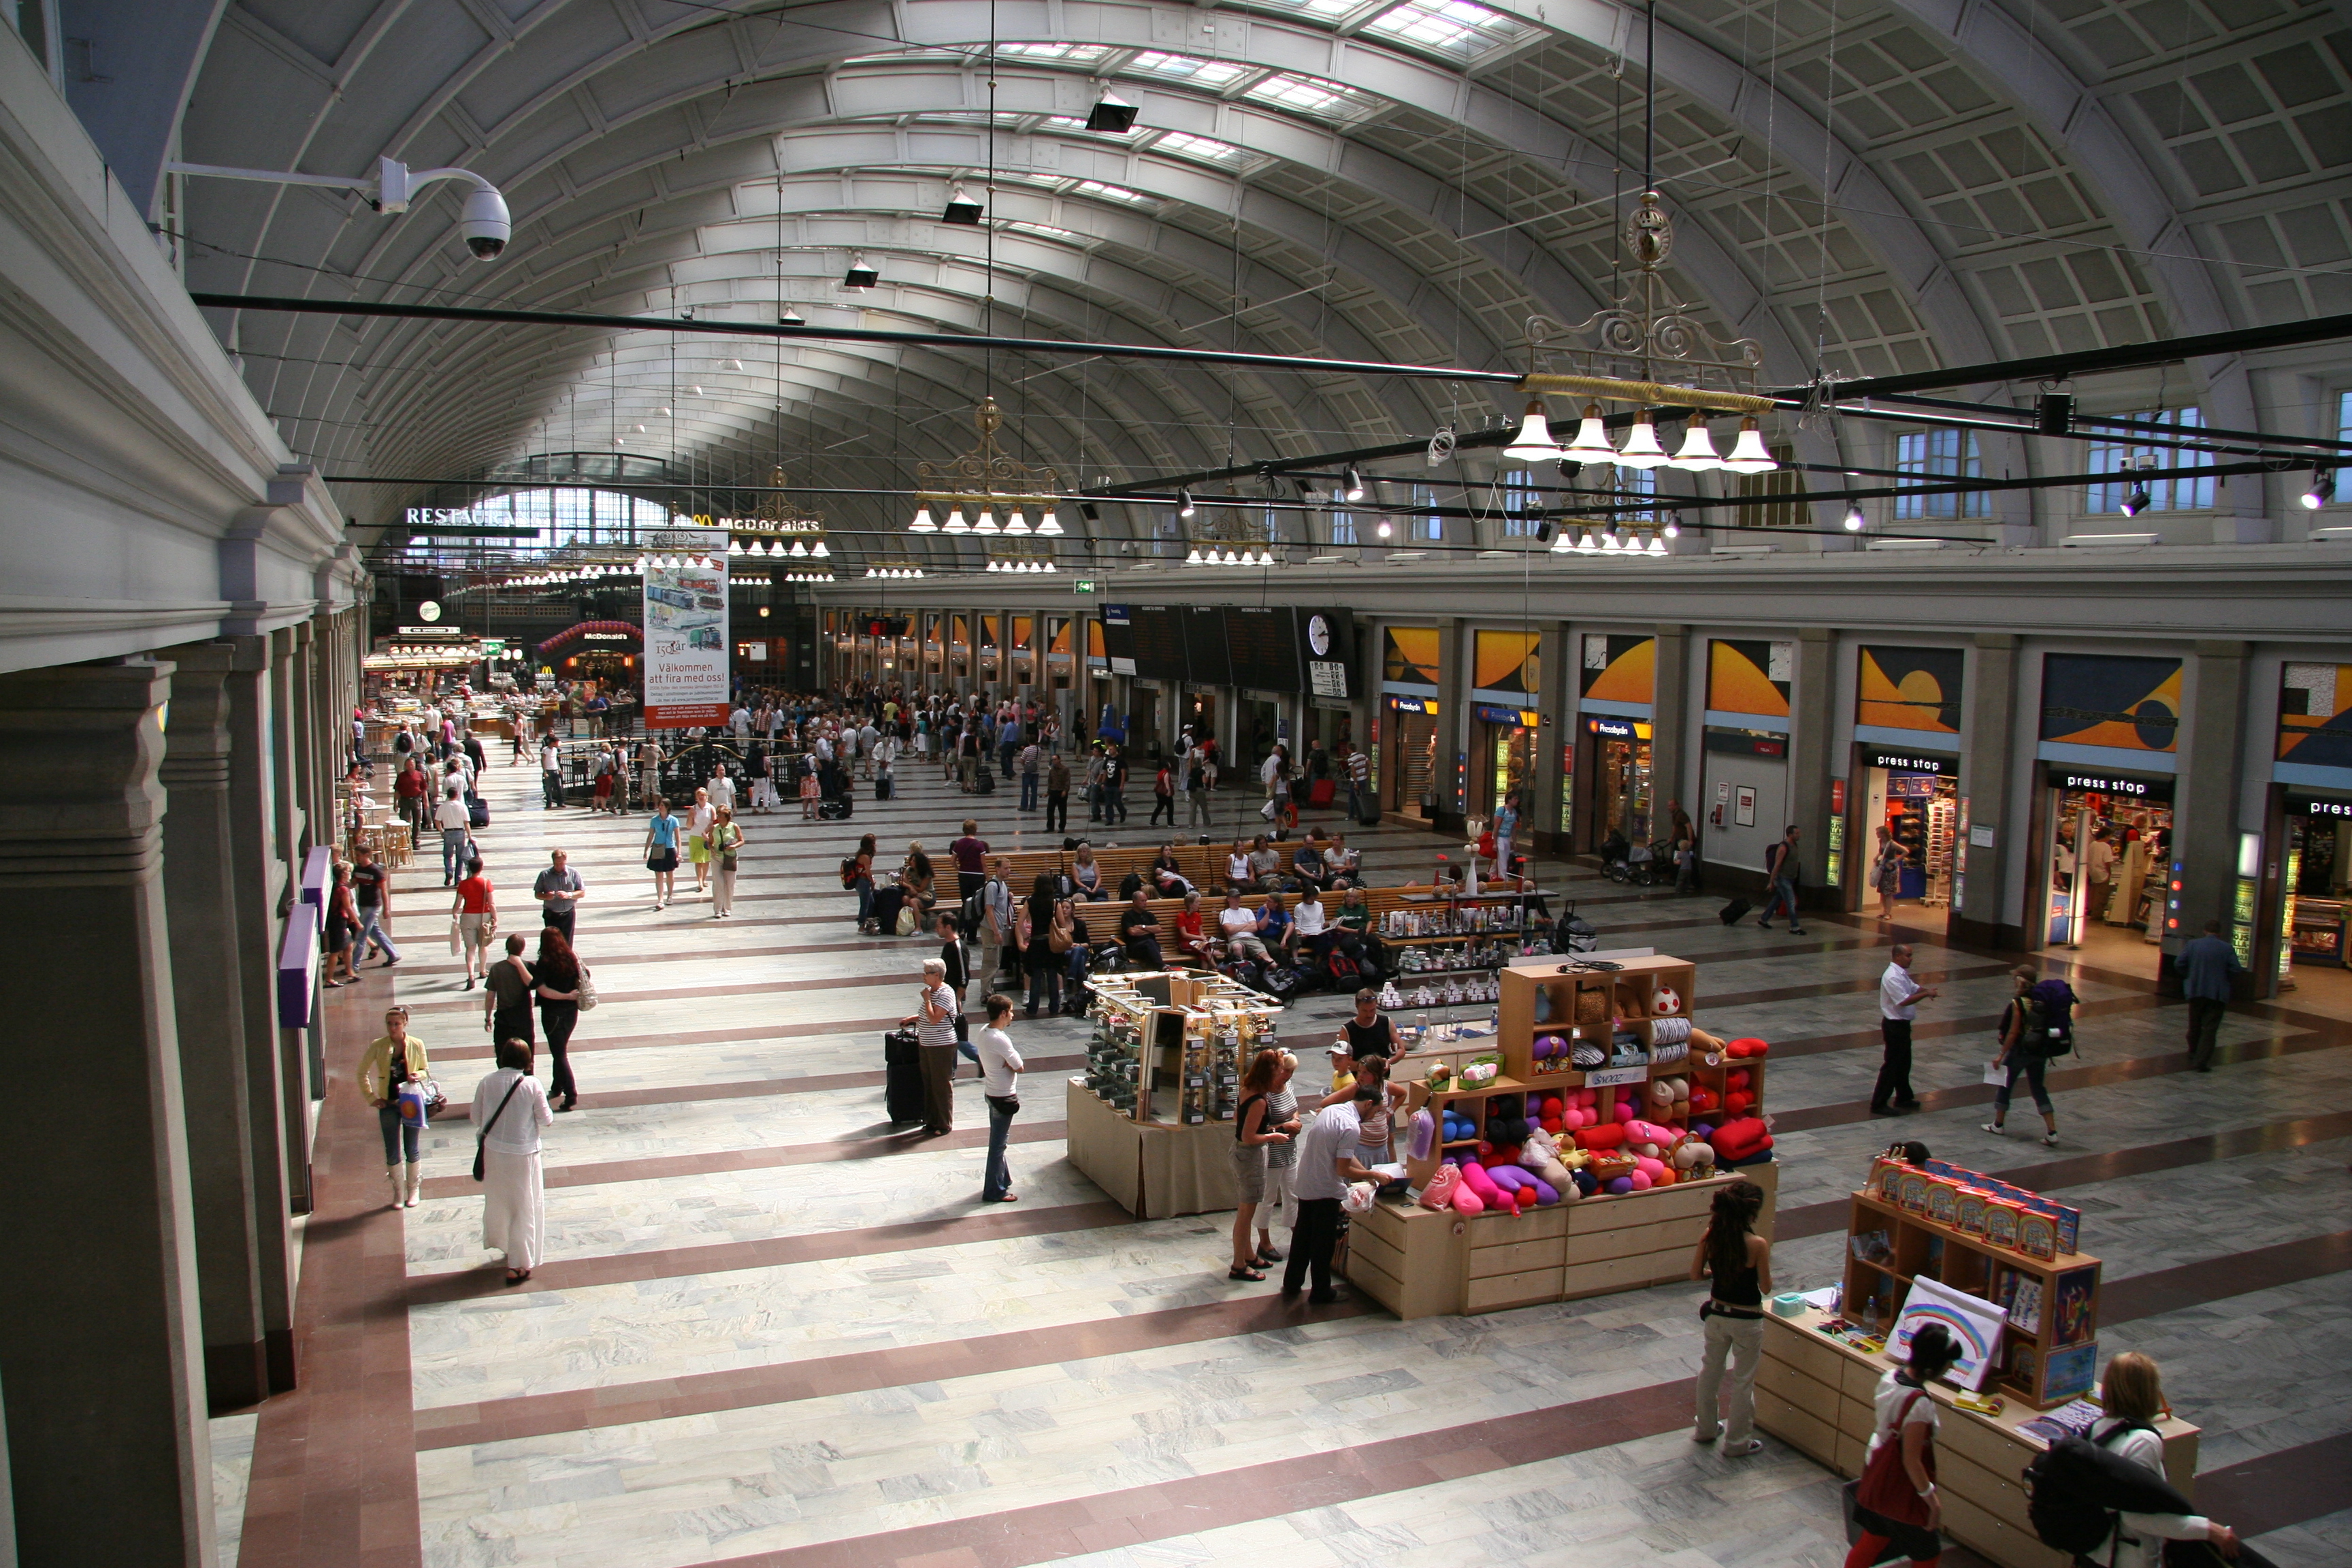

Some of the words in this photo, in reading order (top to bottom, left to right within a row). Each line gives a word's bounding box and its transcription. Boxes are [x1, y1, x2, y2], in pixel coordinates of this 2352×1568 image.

[659, 663, 713, 672] Välkommen
[649, 674, 662, 683] att
[666, 674, 681, 683] fira
[684, 674, 704, 683] med
[706, 673, 725, 682] oss!
[1599, 723, 1629, 736] Pressbyrån
[1878, 755, 1908, 766] press
[1913, 759, 1940, 771] stop
[2068, 776, 2106, 789] press
[2112, 780, 2145, 795] stop
